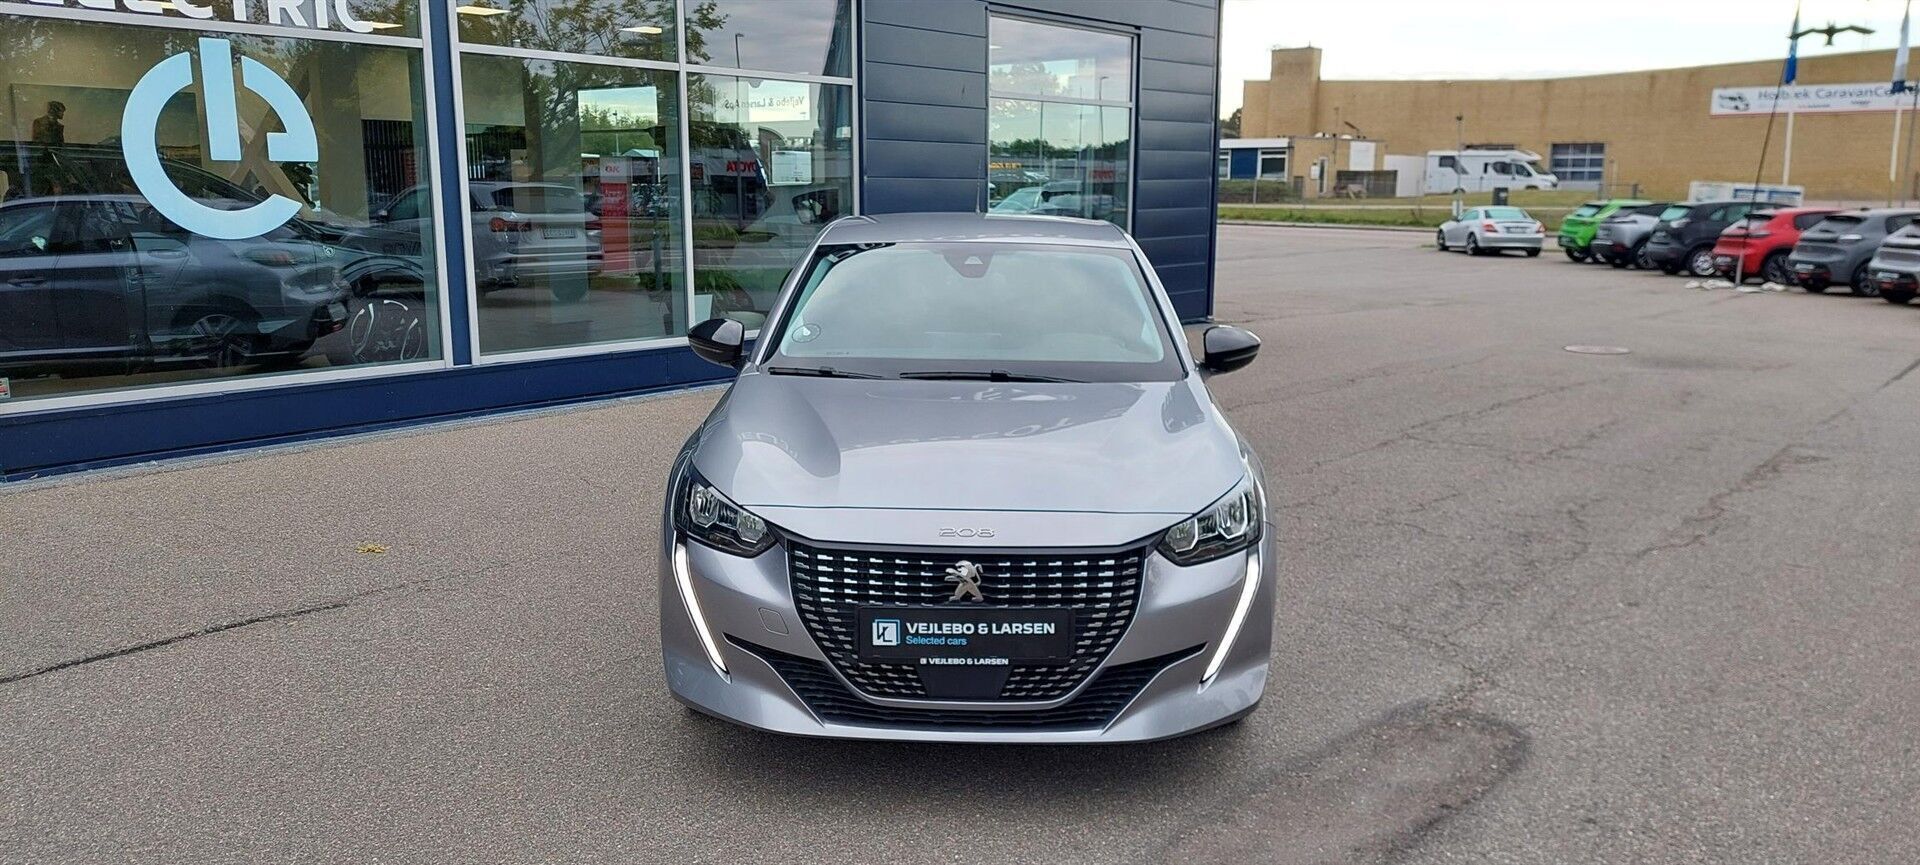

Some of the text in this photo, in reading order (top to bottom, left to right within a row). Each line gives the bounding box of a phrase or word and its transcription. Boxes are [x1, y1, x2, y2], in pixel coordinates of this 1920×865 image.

[939, 528, 995, 538] 208
[906, 622, 1056, 634] VEJLEBO & LARSEN
[905, 635, 968, 646] Selected cars
[928, 657, 1009, 665] VEJLEBO & LARSEN
